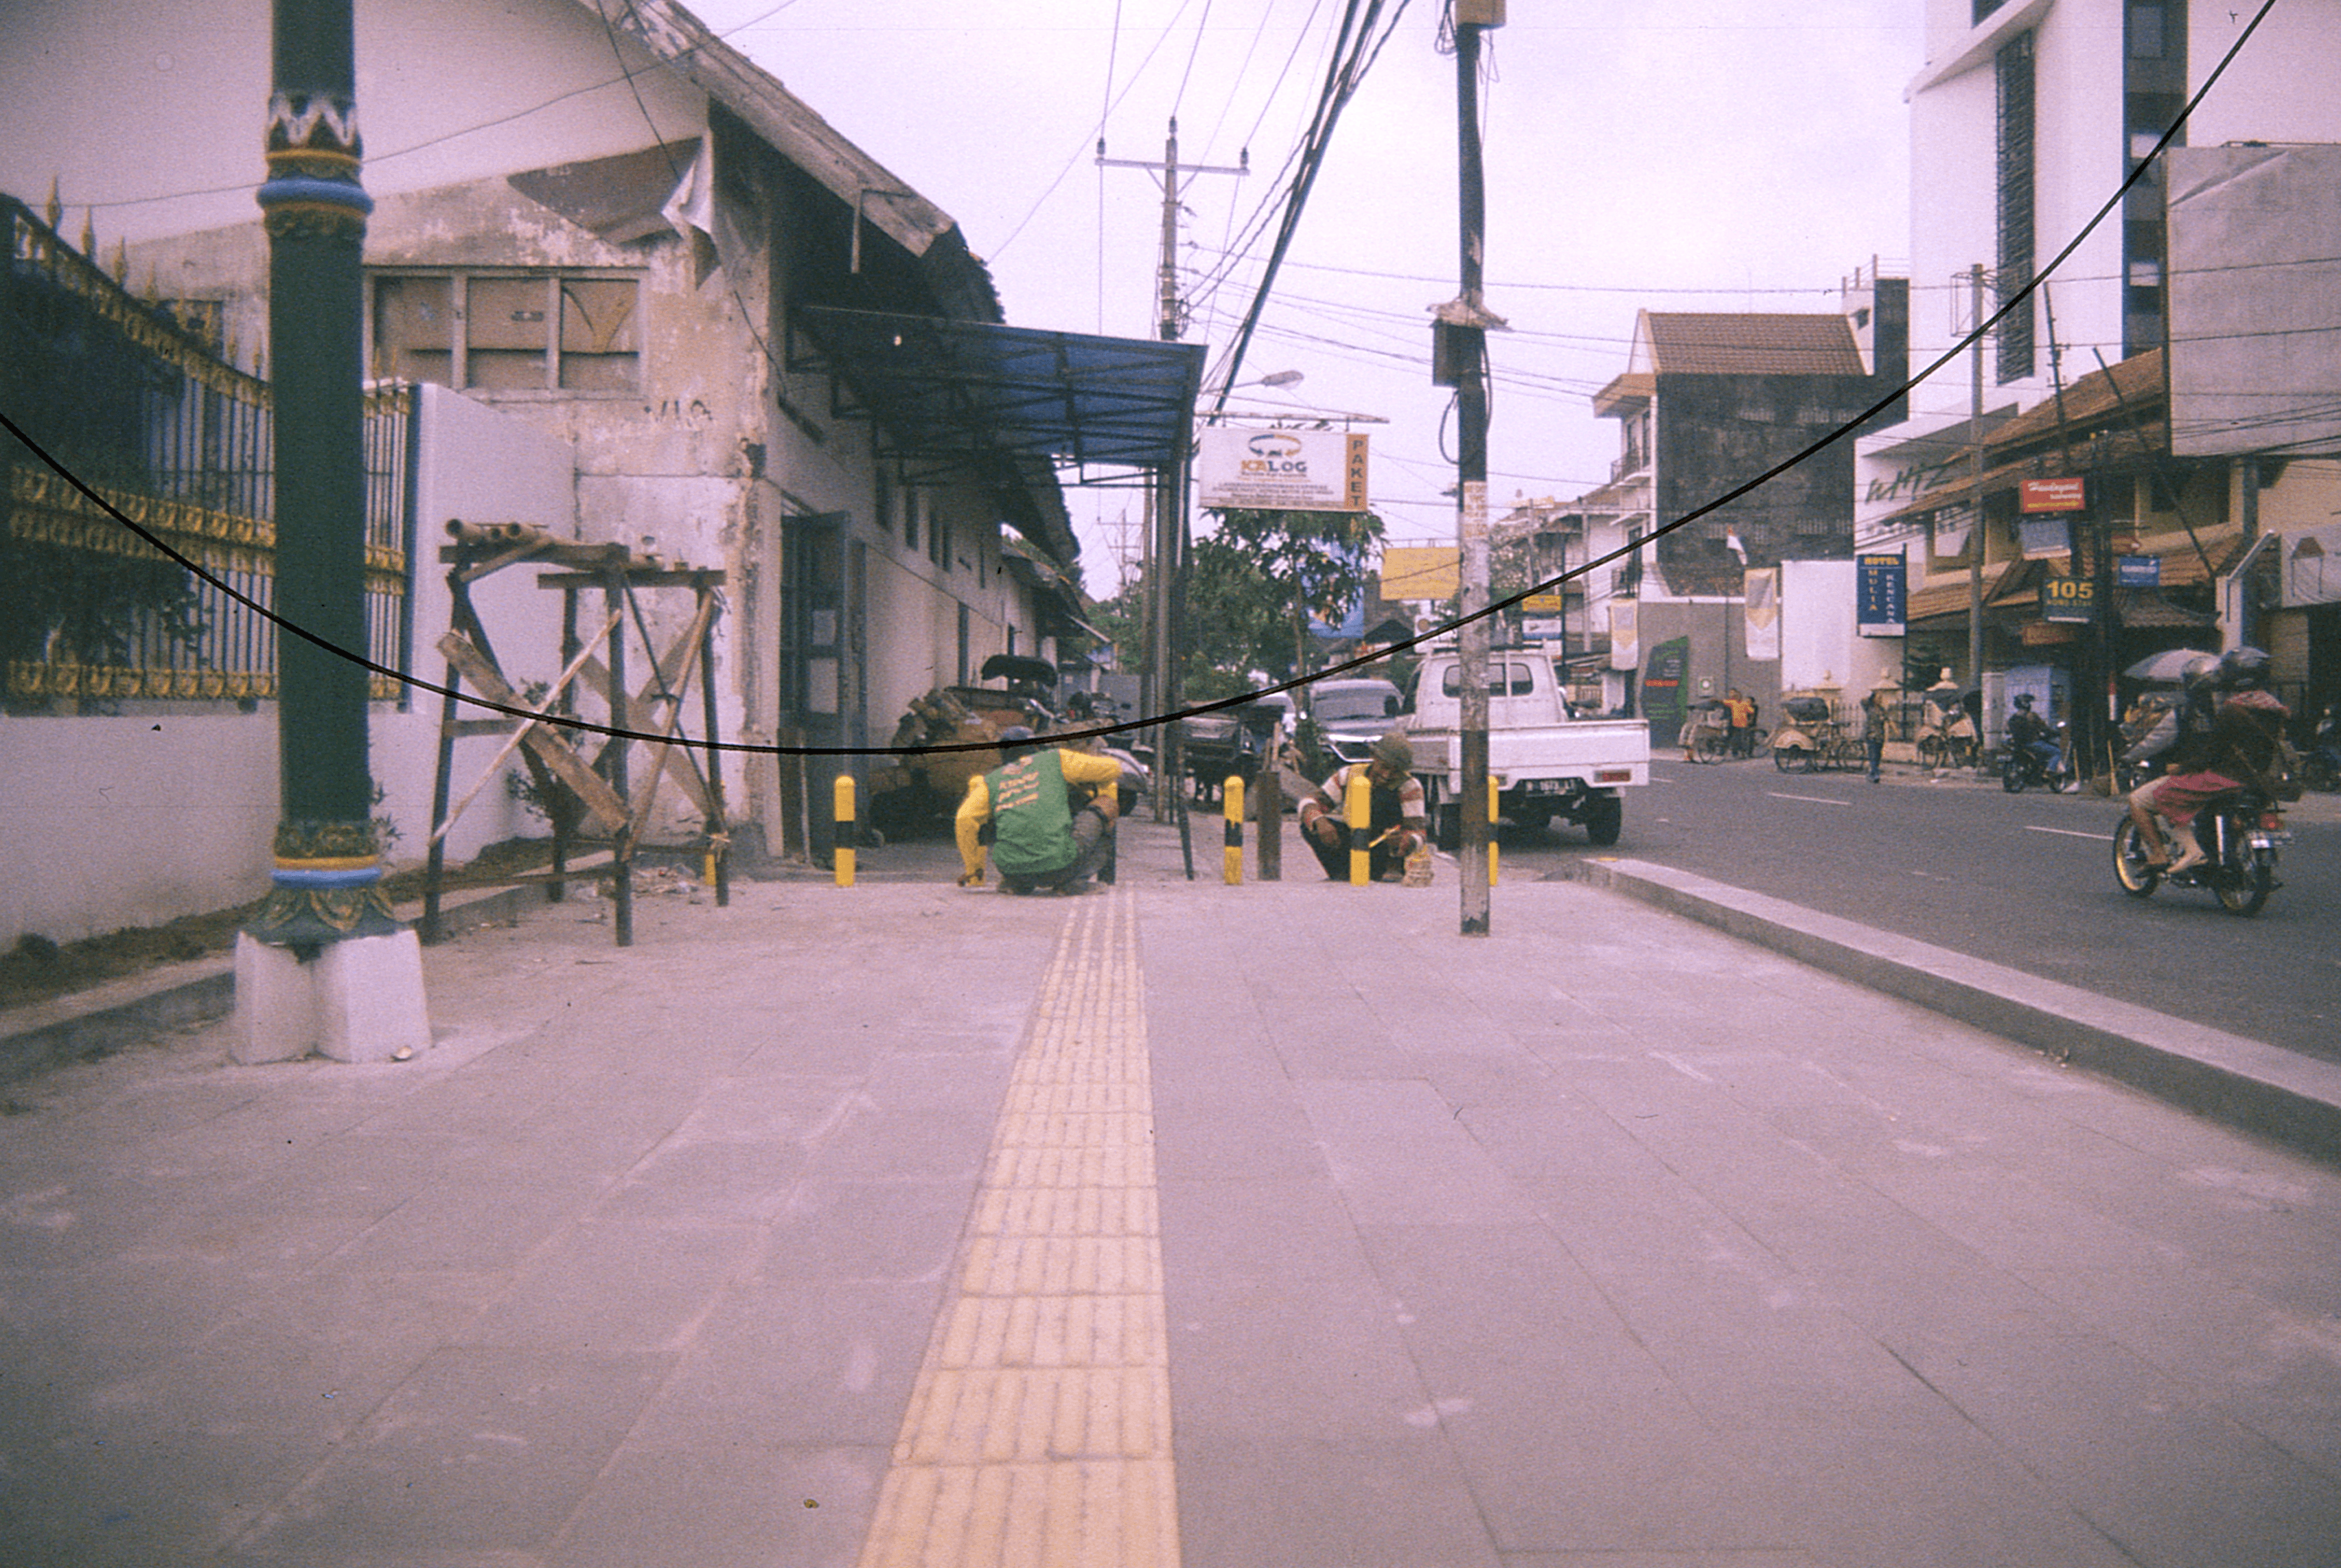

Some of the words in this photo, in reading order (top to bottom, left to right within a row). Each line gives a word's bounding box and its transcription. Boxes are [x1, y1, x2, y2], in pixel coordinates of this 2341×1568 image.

[1350, 440, 1363, 507] PAKET
[1864, 557, 1900, 565] HOTEL
[1869, 569, 1878, 610] MULIA
[1886, 574, 1895, 623] KENCANA
[2046, 580, 2094, 599] 105
